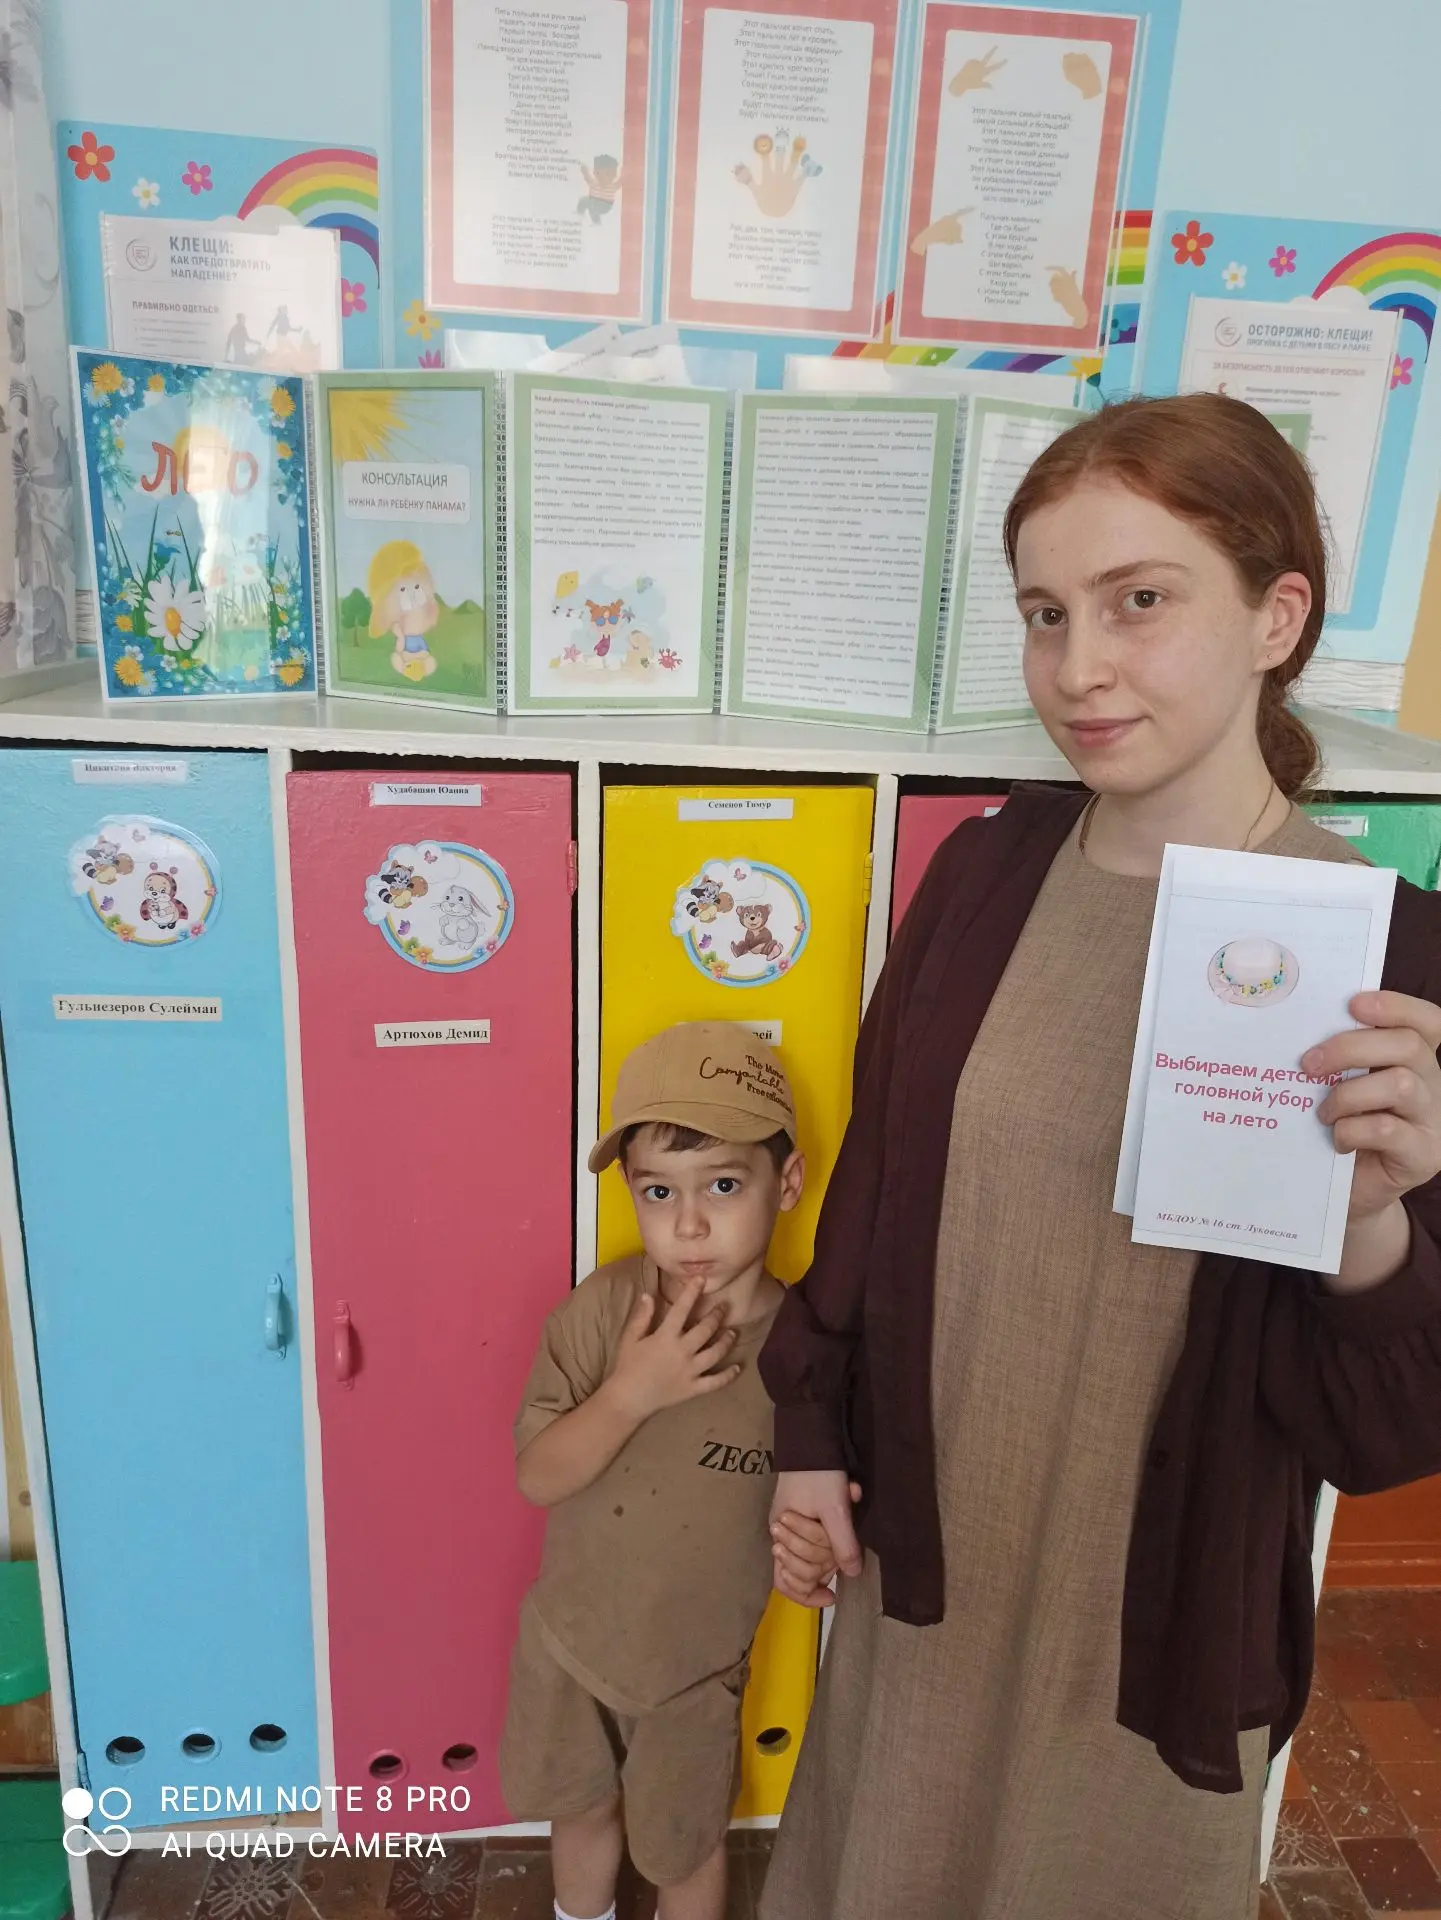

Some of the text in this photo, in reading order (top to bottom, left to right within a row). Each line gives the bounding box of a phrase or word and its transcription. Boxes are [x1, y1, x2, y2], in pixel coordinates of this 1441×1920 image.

[169, 236, 234, 255] КЛЕЩИ:
[170, 254, 272, 273] КАК ПРЕДОТВРАТИТЬ
[171, 268, 239, 282] НАПАДЕНИЕ?
[132, 300, 181, 313] ПРАВИЛЬНО
[1248, 324, 1374, 343] ОСТОРОЖНО: КЛЕЩИ!
[362, 472, 449, 490] КОНСУЛЬТАЦИЯ
[348, 497, 375, 508] НУЖНА
[377, 498, 389, 508] ЛИ
[426, 500, 467, 512] ПАНАМА?
[387, 785, 436, 796] Худабашян
[708, 800, 772, 810] Семенов Тимур
[58, 1000, 218, 1016] Гульнезеров Сулейман
[384, 1027, 489, 1042] Артюхов Демид
[745, 1054, 764, 1071] The
[1155, 1053, 1258, 1078] Выбираем
[1174, 1081, 1315, 1113] головной убор
[1202, 1110, 1279, 1131] на лето
[1156, 1211, 1299, 1240] МБДОУ № 16 ст. Луковская
